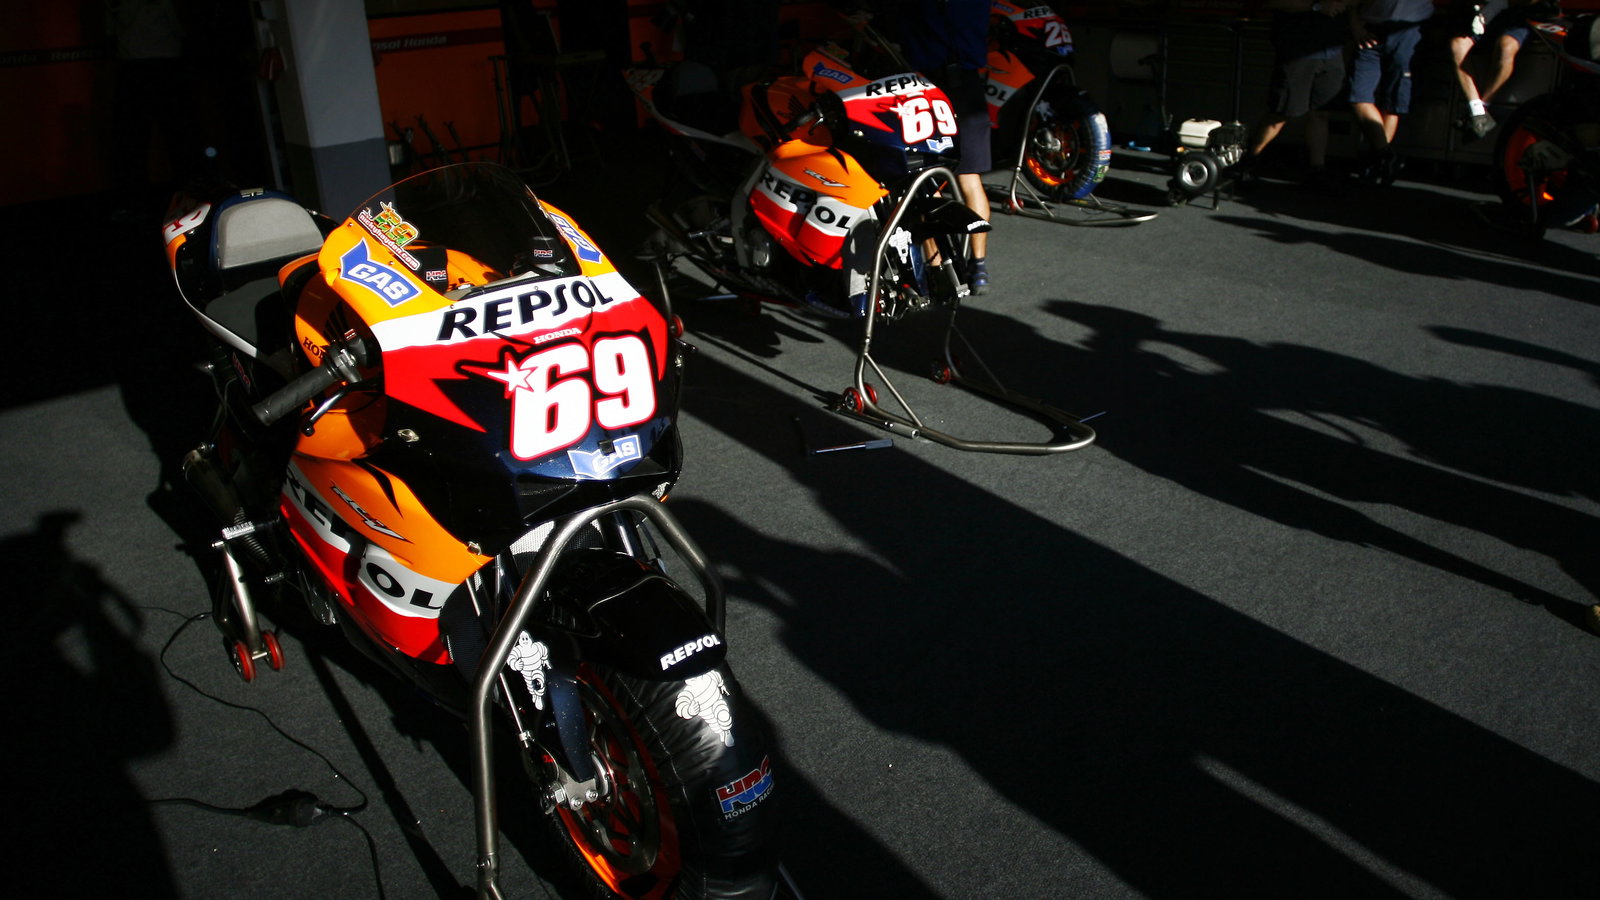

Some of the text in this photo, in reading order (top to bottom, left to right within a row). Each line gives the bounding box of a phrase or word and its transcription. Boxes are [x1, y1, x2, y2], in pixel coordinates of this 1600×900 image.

[1044, 20, 1074, 48] 26
[0, 53, 38, 65] onda
[901, 97, 957, 144] 69
[347, 263, 409, 300] GAS
[436, 279, 614, 341] REPSOL
[533, 327, 583, 345] HONDA
[509, 334, 657, 461] 69
[660, 634, 721, 671] REPSOL
[725, 801, 758, 820] HONDA
